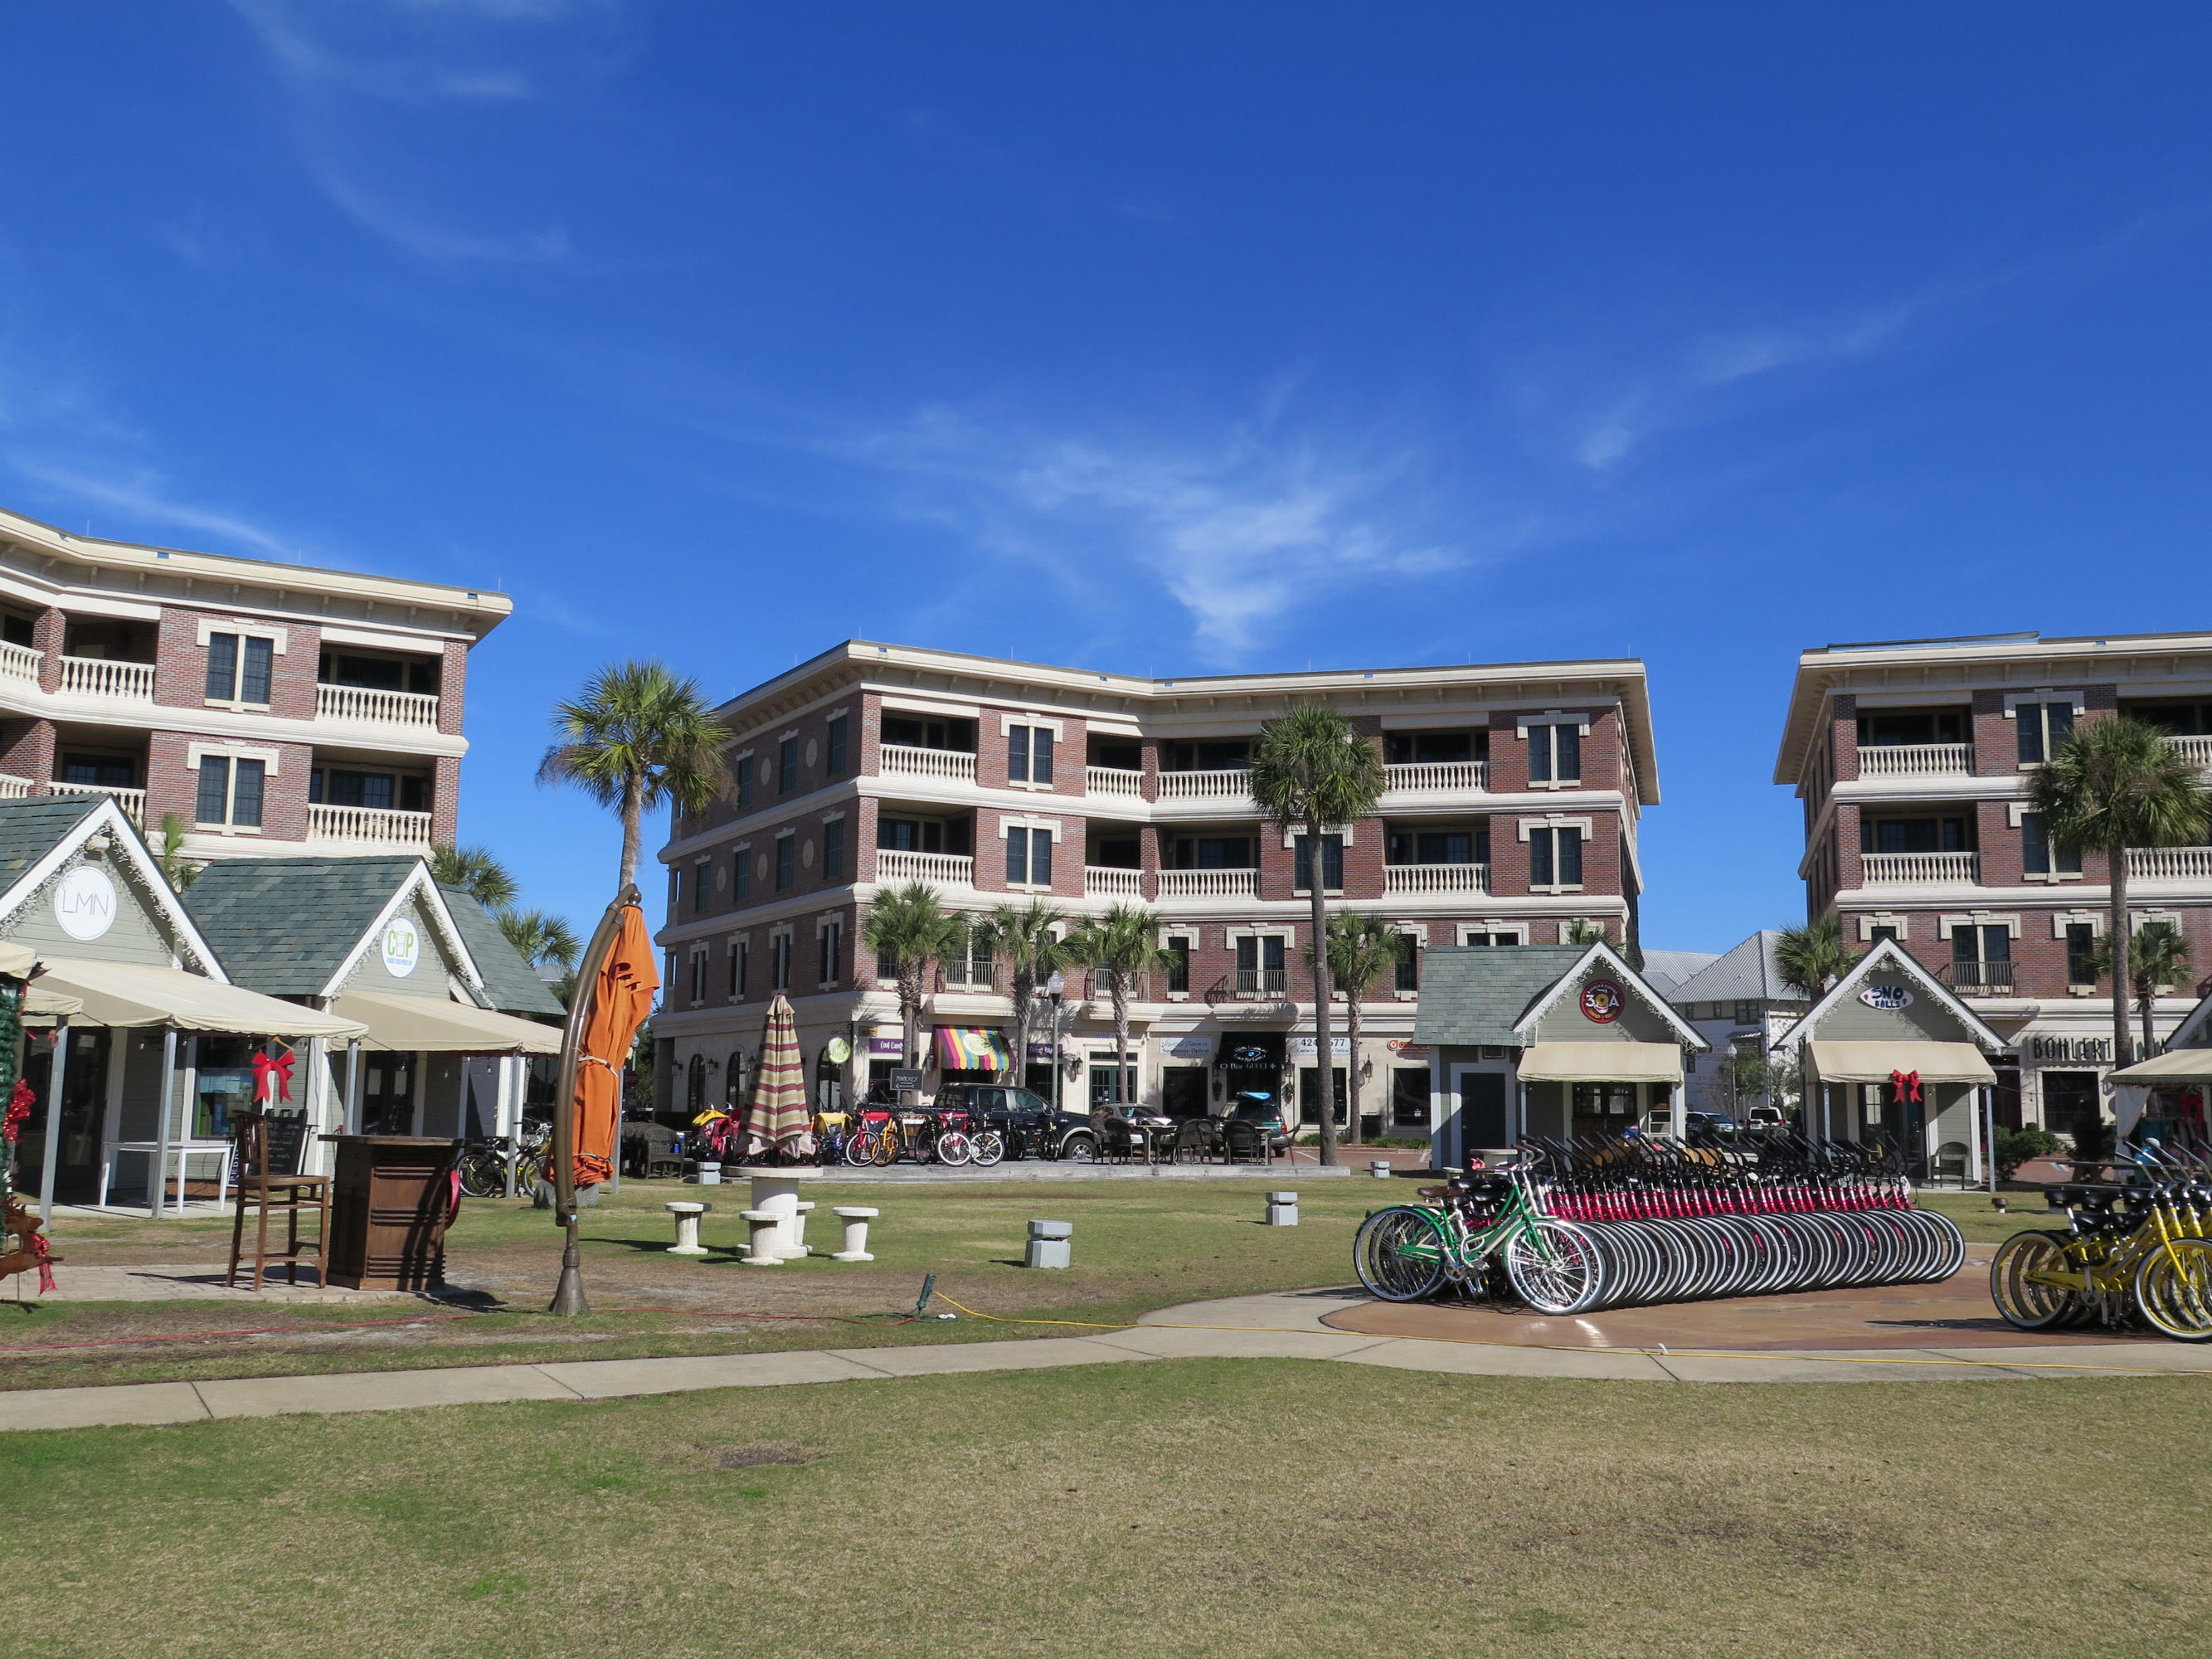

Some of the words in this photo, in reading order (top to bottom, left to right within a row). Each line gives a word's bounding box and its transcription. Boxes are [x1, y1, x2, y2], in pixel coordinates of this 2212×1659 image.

[61, 889, 110, 917] LMN
[1871, 985, 1903, 1000] SNO
[1875, 1000, 1901, 1009] BALLS
[2033, 1037, 2113, 1060] BOHLERT
